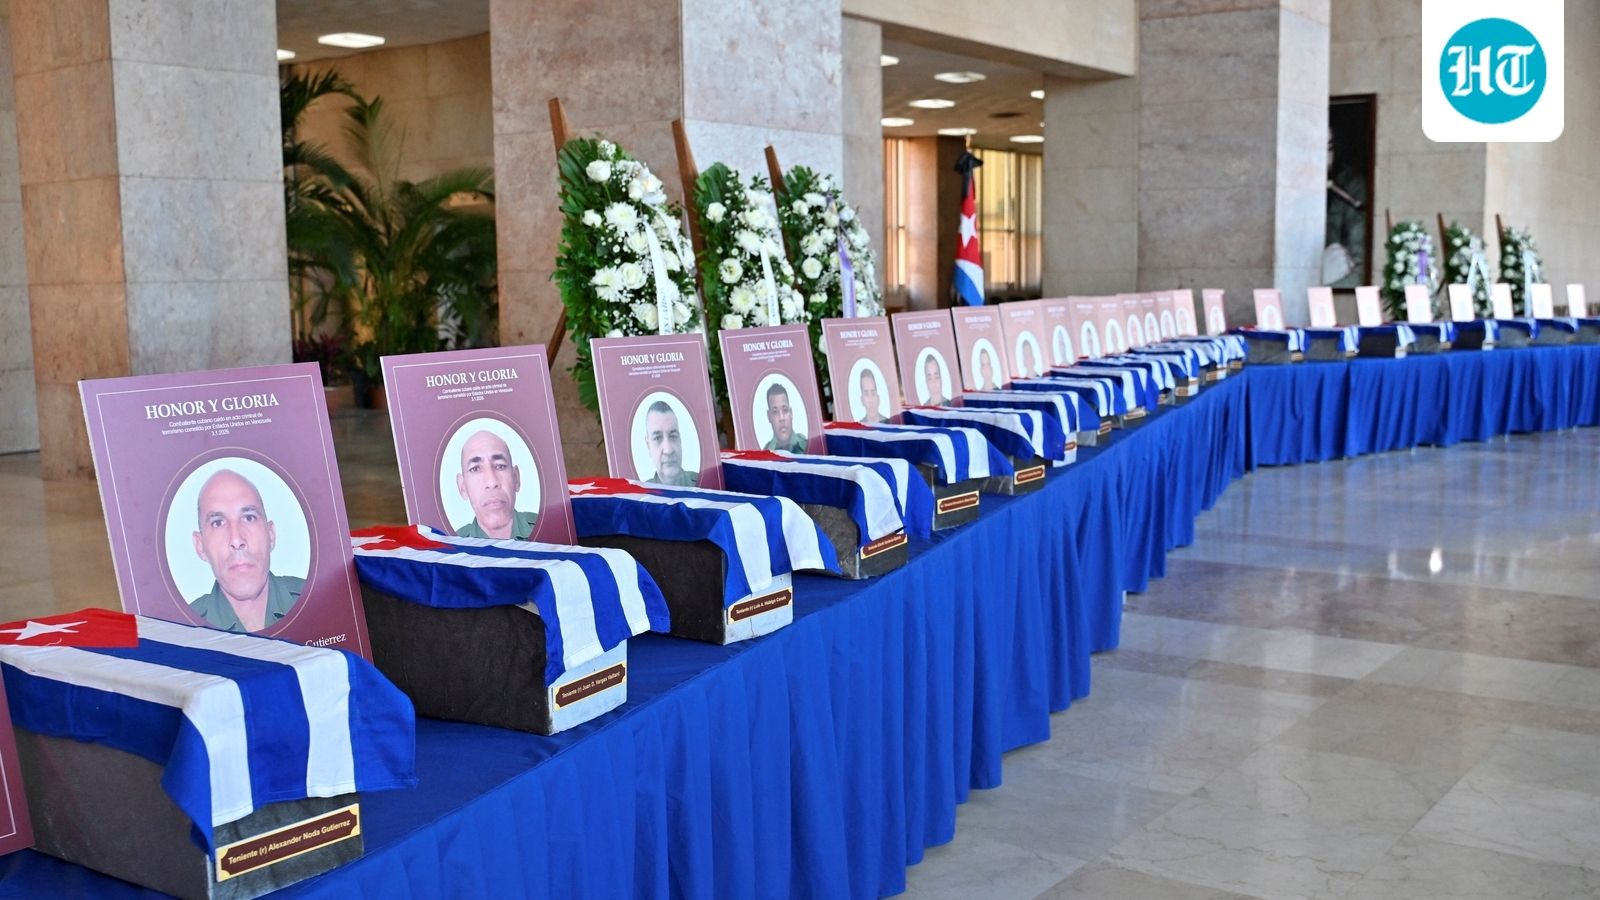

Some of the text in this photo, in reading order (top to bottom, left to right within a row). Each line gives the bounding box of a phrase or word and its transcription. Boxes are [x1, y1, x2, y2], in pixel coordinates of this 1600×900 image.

[743, 342, 766, 352] HONOR
[771, 339, 793, 349] GLORIA
[621, 352, 684, 365] HONOR Y GLORIA
[426, 368, 518, 387] HONOR Y GLORIA
[145, 393, 279, 419] HONOR Y GLORIA
[169, 419, 196, 427] Combatiente
[305, 633, 347, 647] Gutierrez
[228, 819, 350, 864] Teniente (r) Alexander Noda Gutierrez
